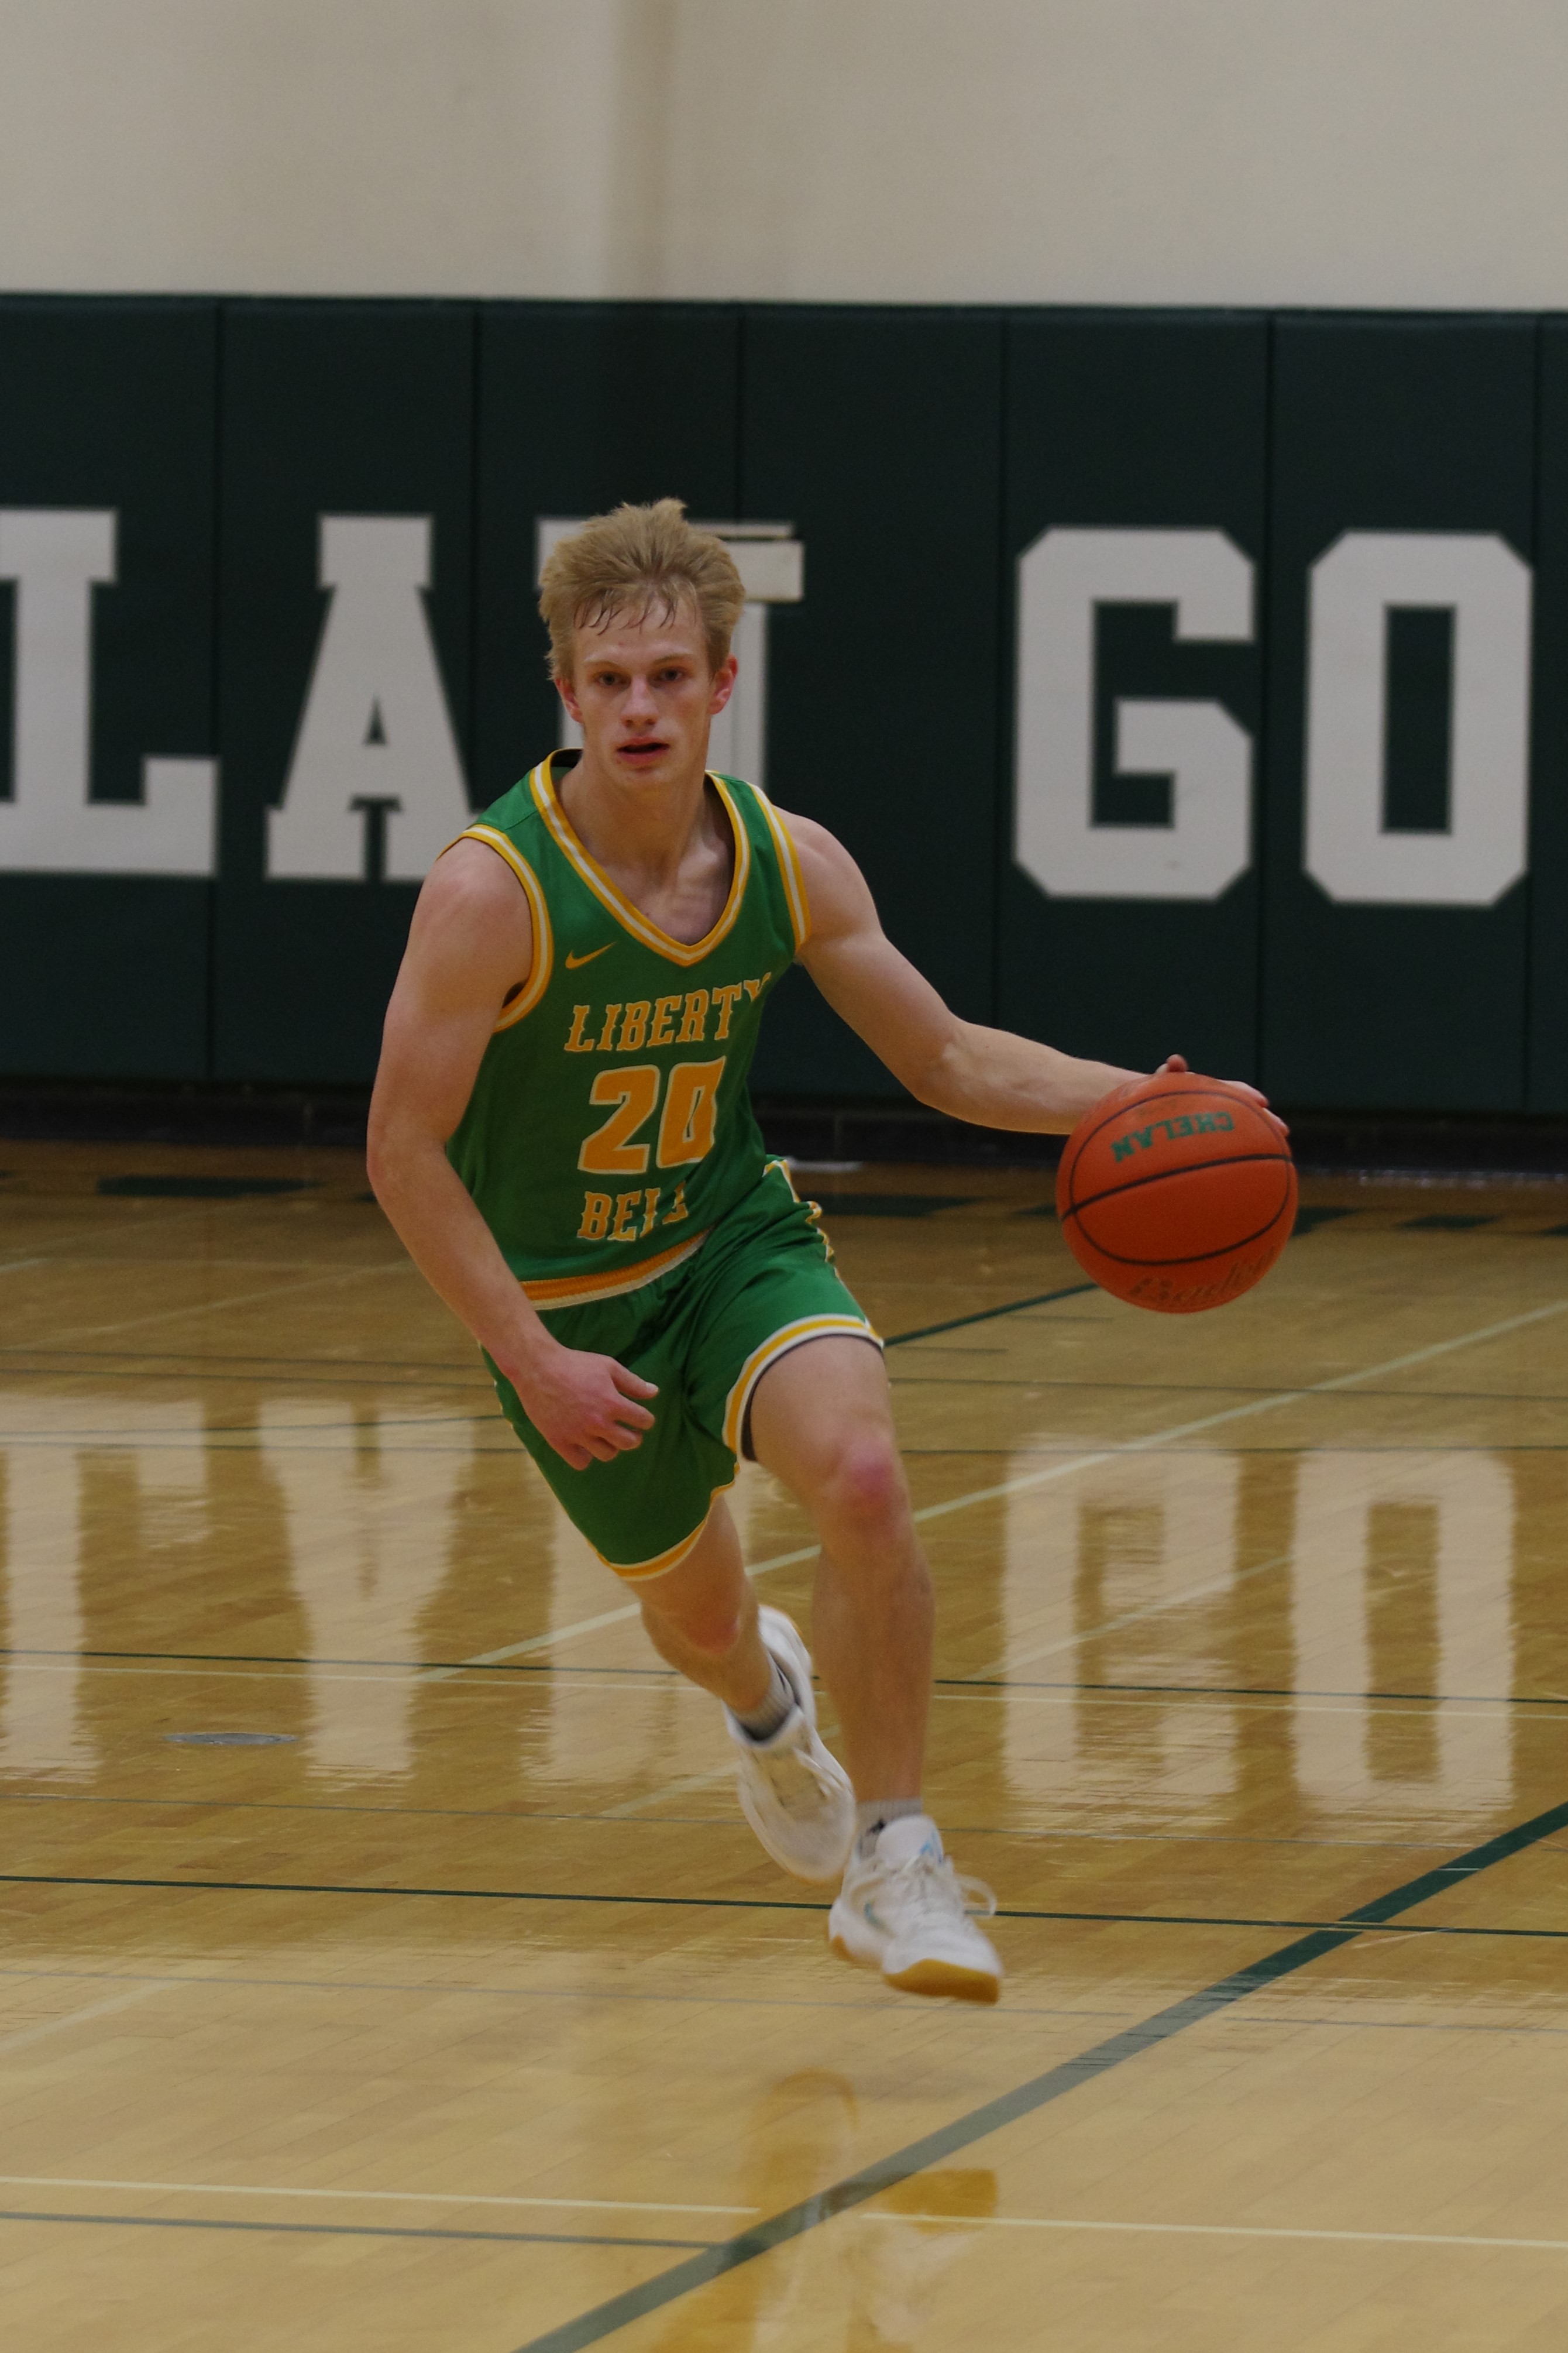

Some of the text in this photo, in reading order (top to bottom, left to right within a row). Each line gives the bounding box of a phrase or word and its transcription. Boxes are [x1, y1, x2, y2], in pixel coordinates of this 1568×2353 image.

[1013, 527, 1533, 907] GO
[577, 1056, 726, 1174] 20
[1110, 1111, 1235, 1163] CHELAN
